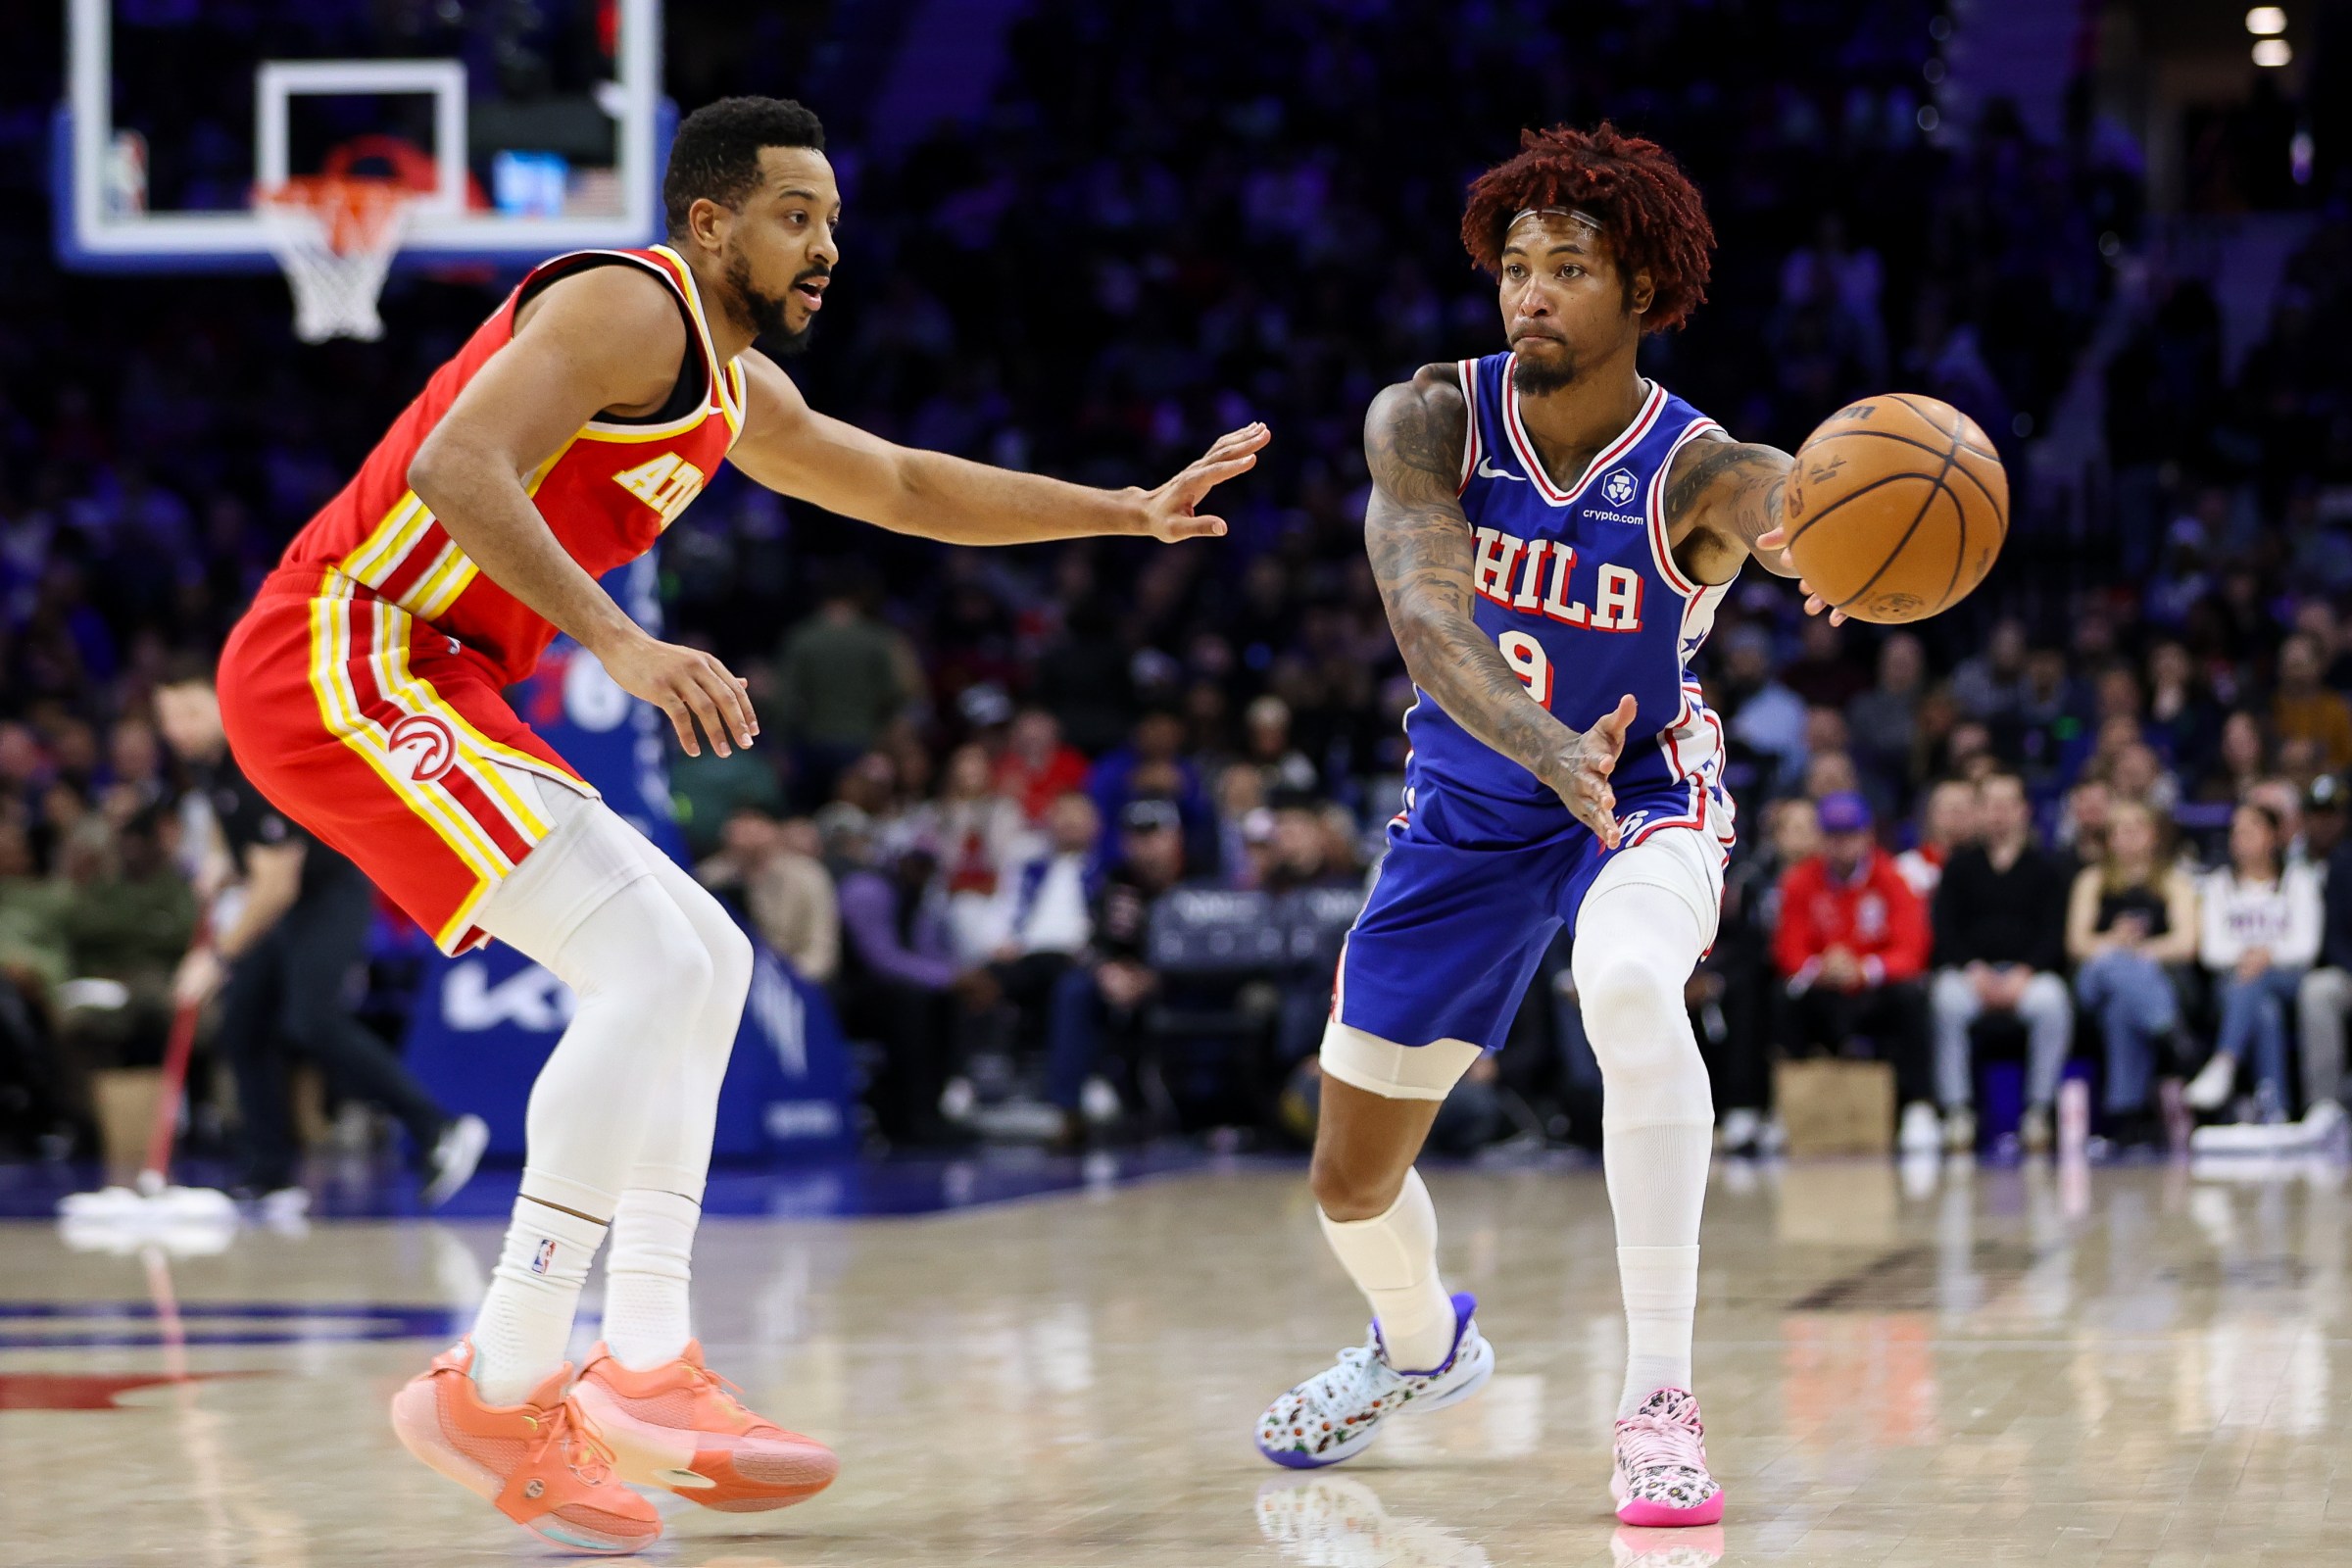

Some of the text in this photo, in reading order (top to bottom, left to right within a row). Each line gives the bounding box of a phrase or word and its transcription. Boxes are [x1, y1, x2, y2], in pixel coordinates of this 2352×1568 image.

[1583, 510, 1643, 525] crypto.com
[1469, 522, 1644, 633] HILA
[1498, 630, 1553, 711] 9
